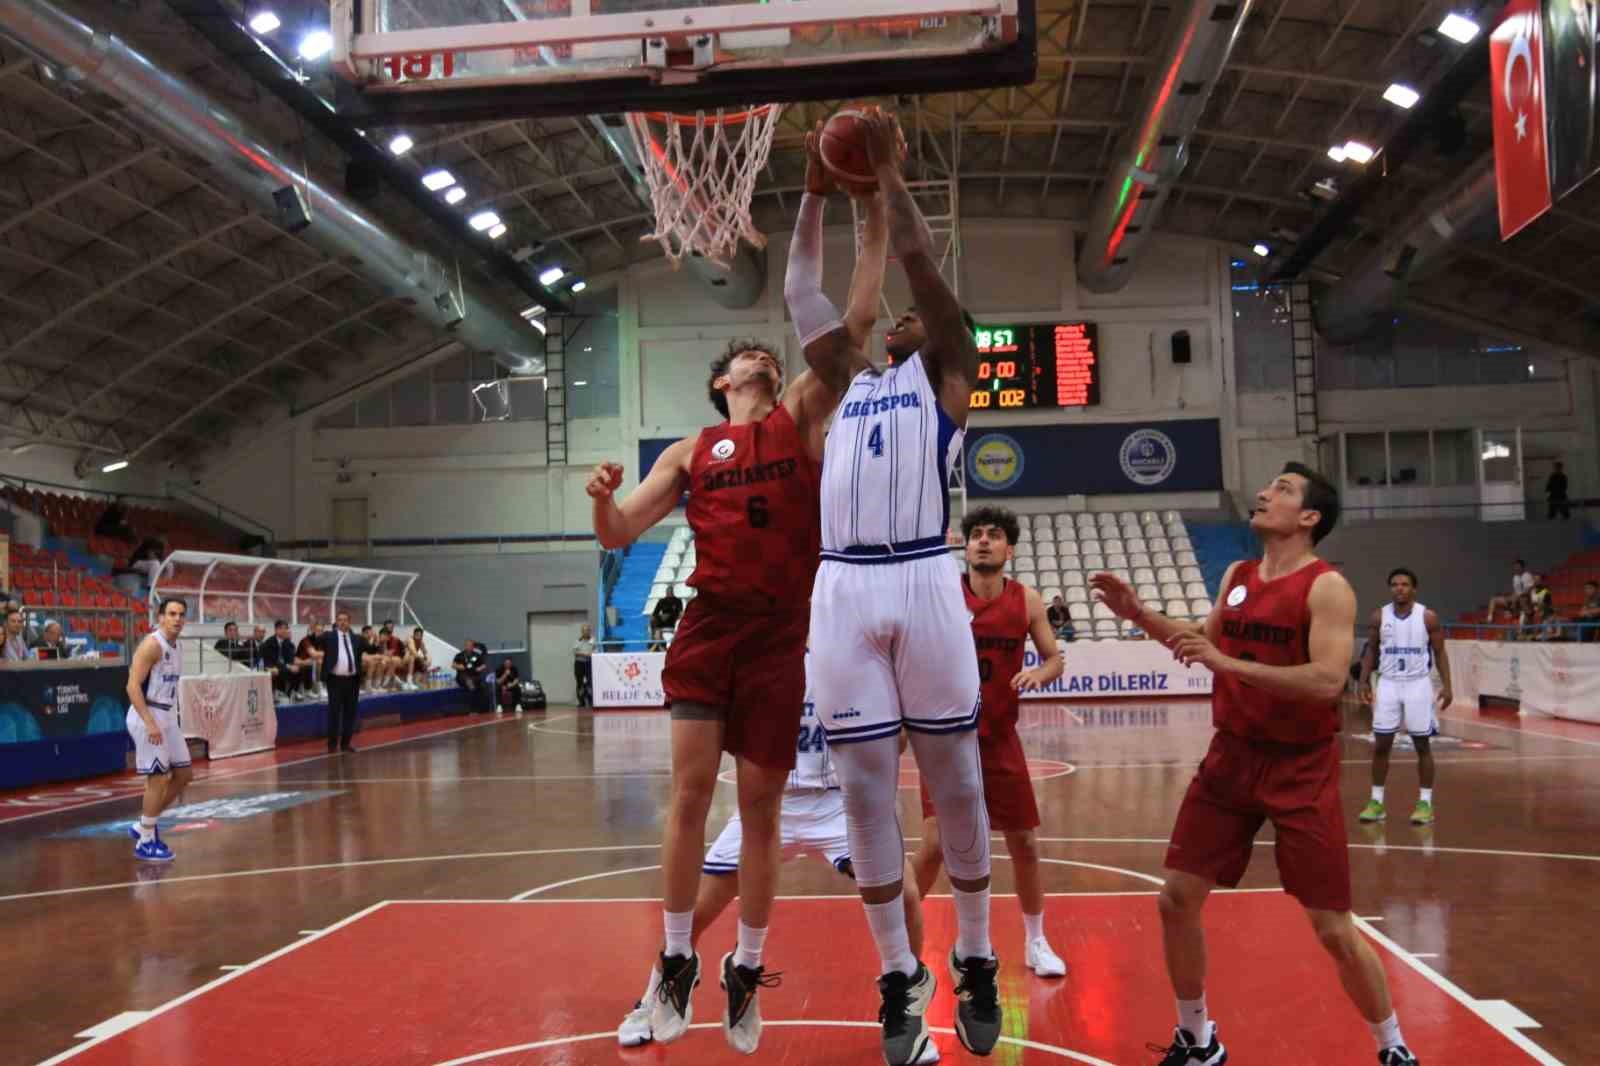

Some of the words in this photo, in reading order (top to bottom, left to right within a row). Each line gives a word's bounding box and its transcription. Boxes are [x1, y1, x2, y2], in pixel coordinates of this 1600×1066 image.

[1000, 389, 1025, 407] 002
[868, 421, 884, 457] 4
[748, 496, 768, 528] 6
[1098, 670, 1168, 692] DİLERİZ
[798, 724, 824, 752] 24
